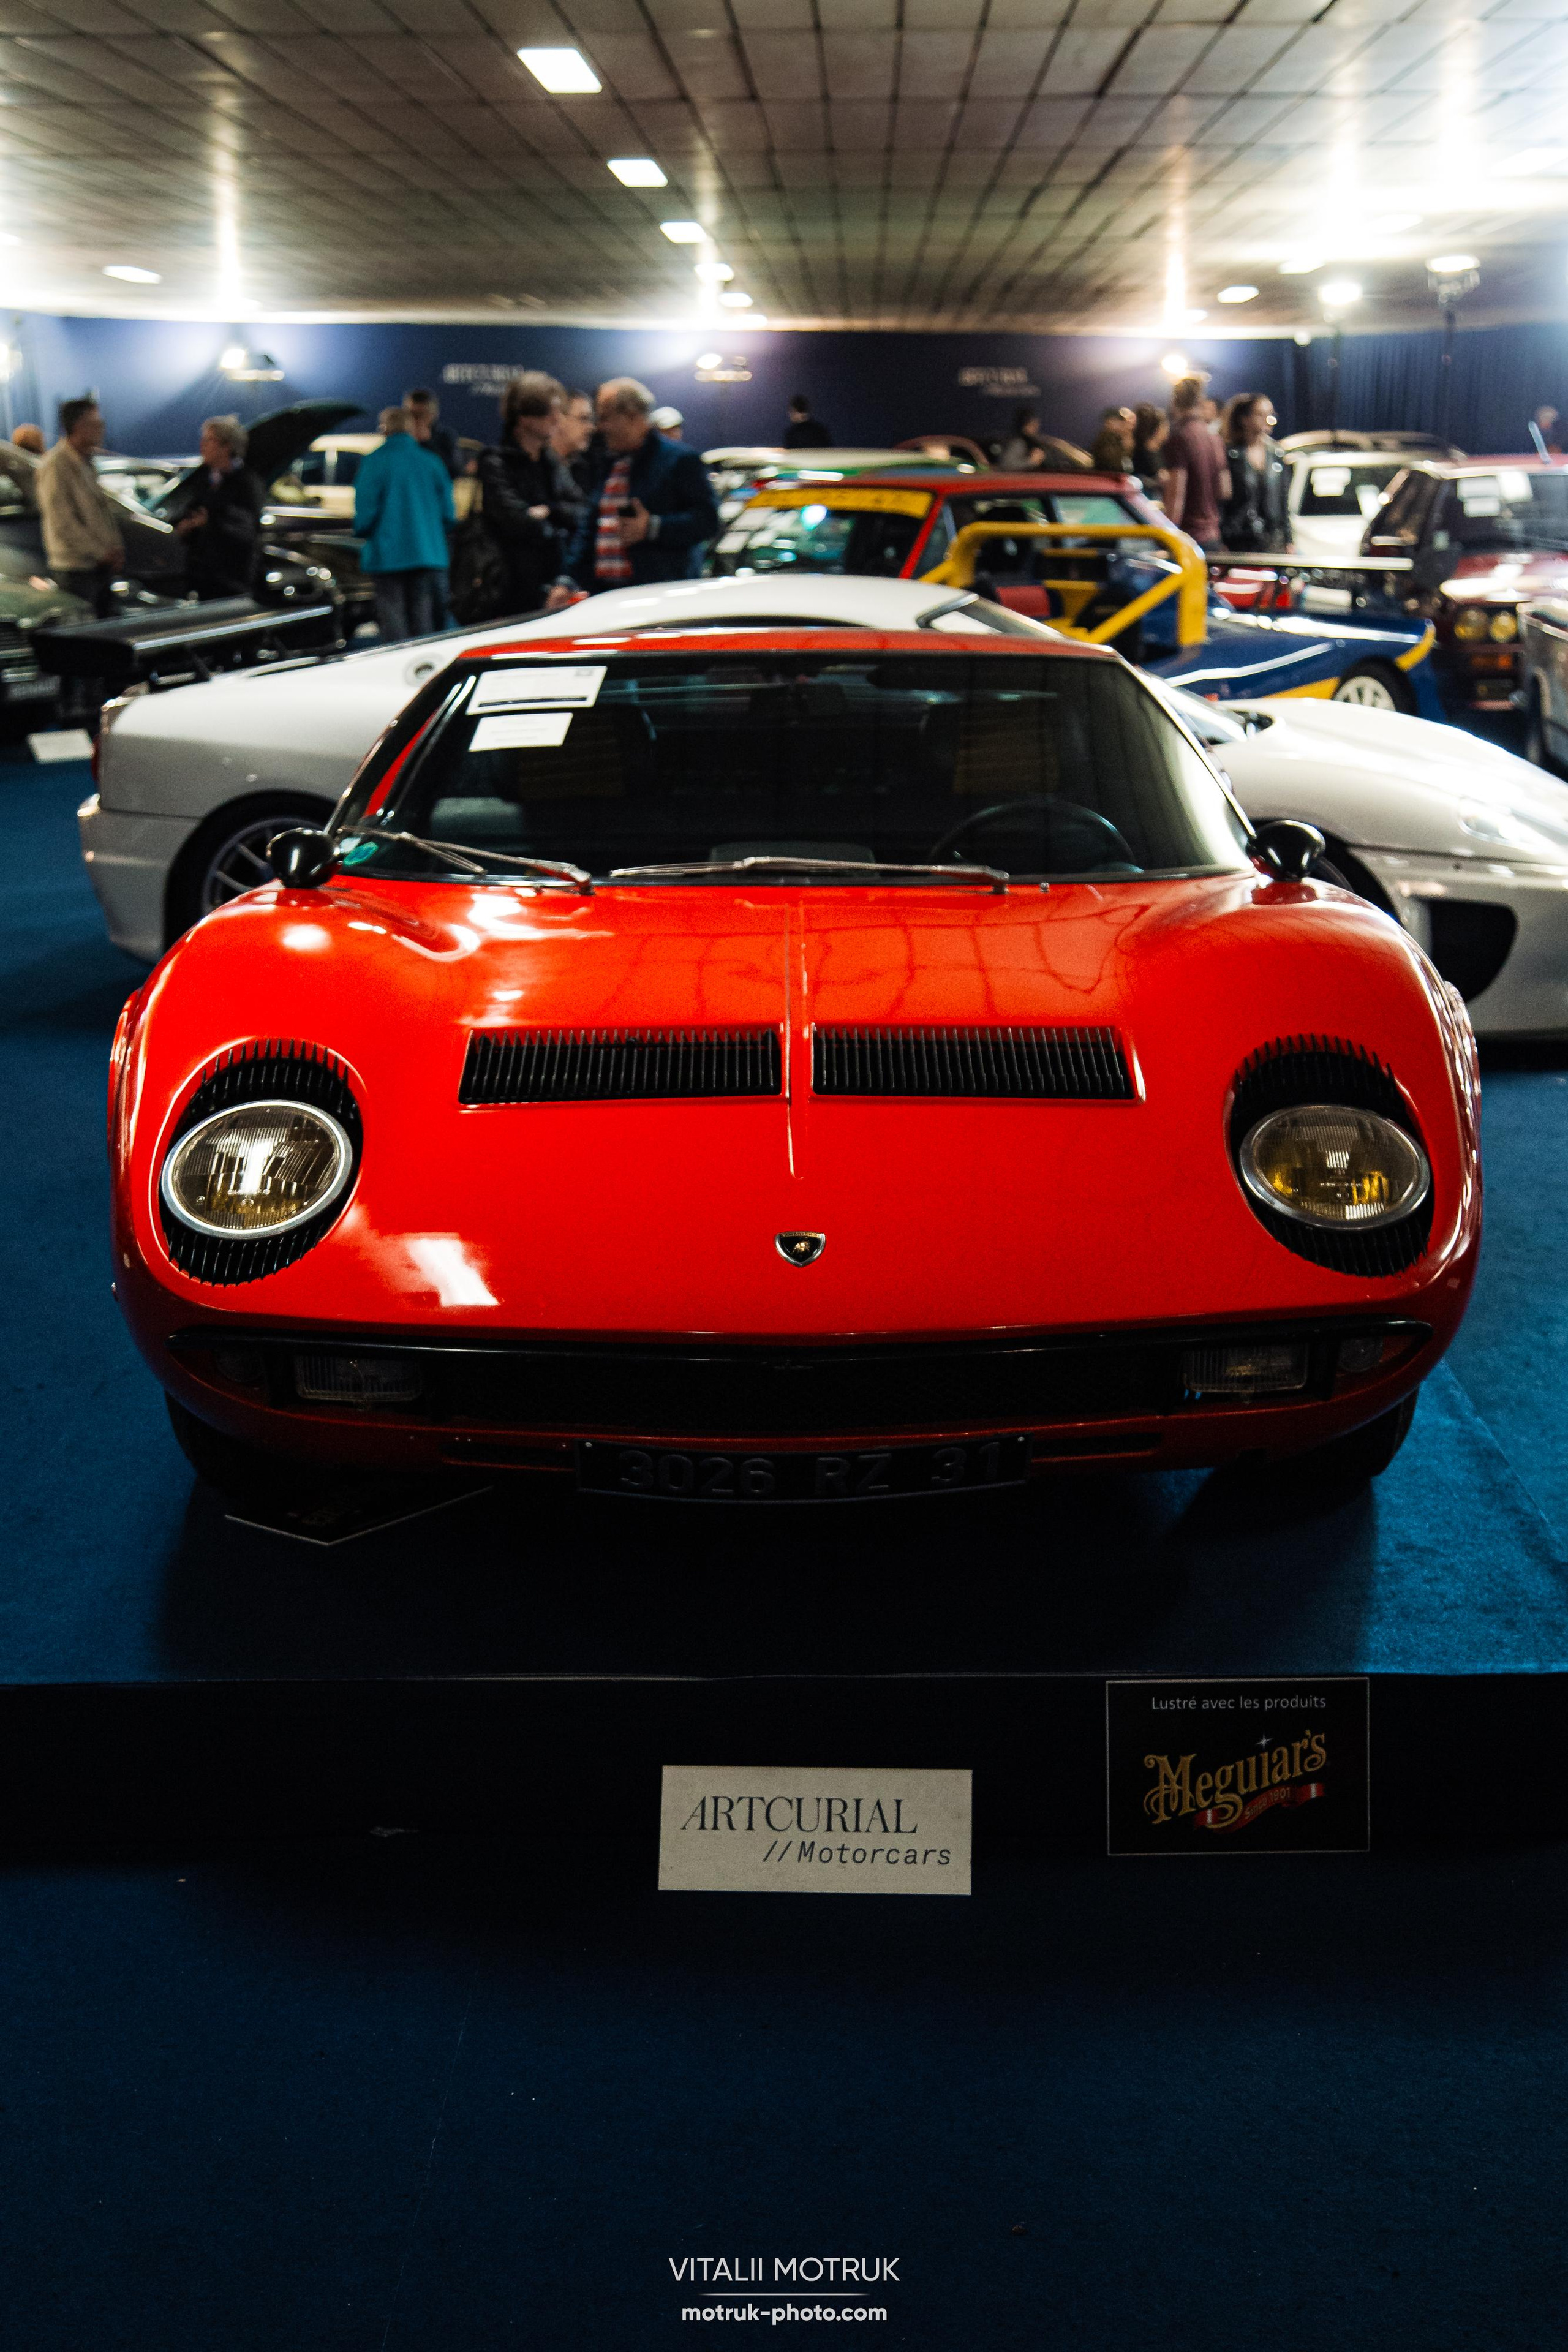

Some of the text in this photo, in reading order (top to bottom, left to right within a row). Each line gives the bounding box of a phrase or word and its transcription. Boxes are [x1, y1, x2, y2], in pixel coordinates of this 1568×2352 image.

[617, 1441, 1002, 1498] 3026 RZ 31
[1152, 1694, 1327, 1711] Lustré avec les produits
[1143, 1729, 1328, 1829] Meguiar's
[1269, 1786, 1292, 1803] 1901
[680, 1795, 918, 1834] ARTCURIAL
